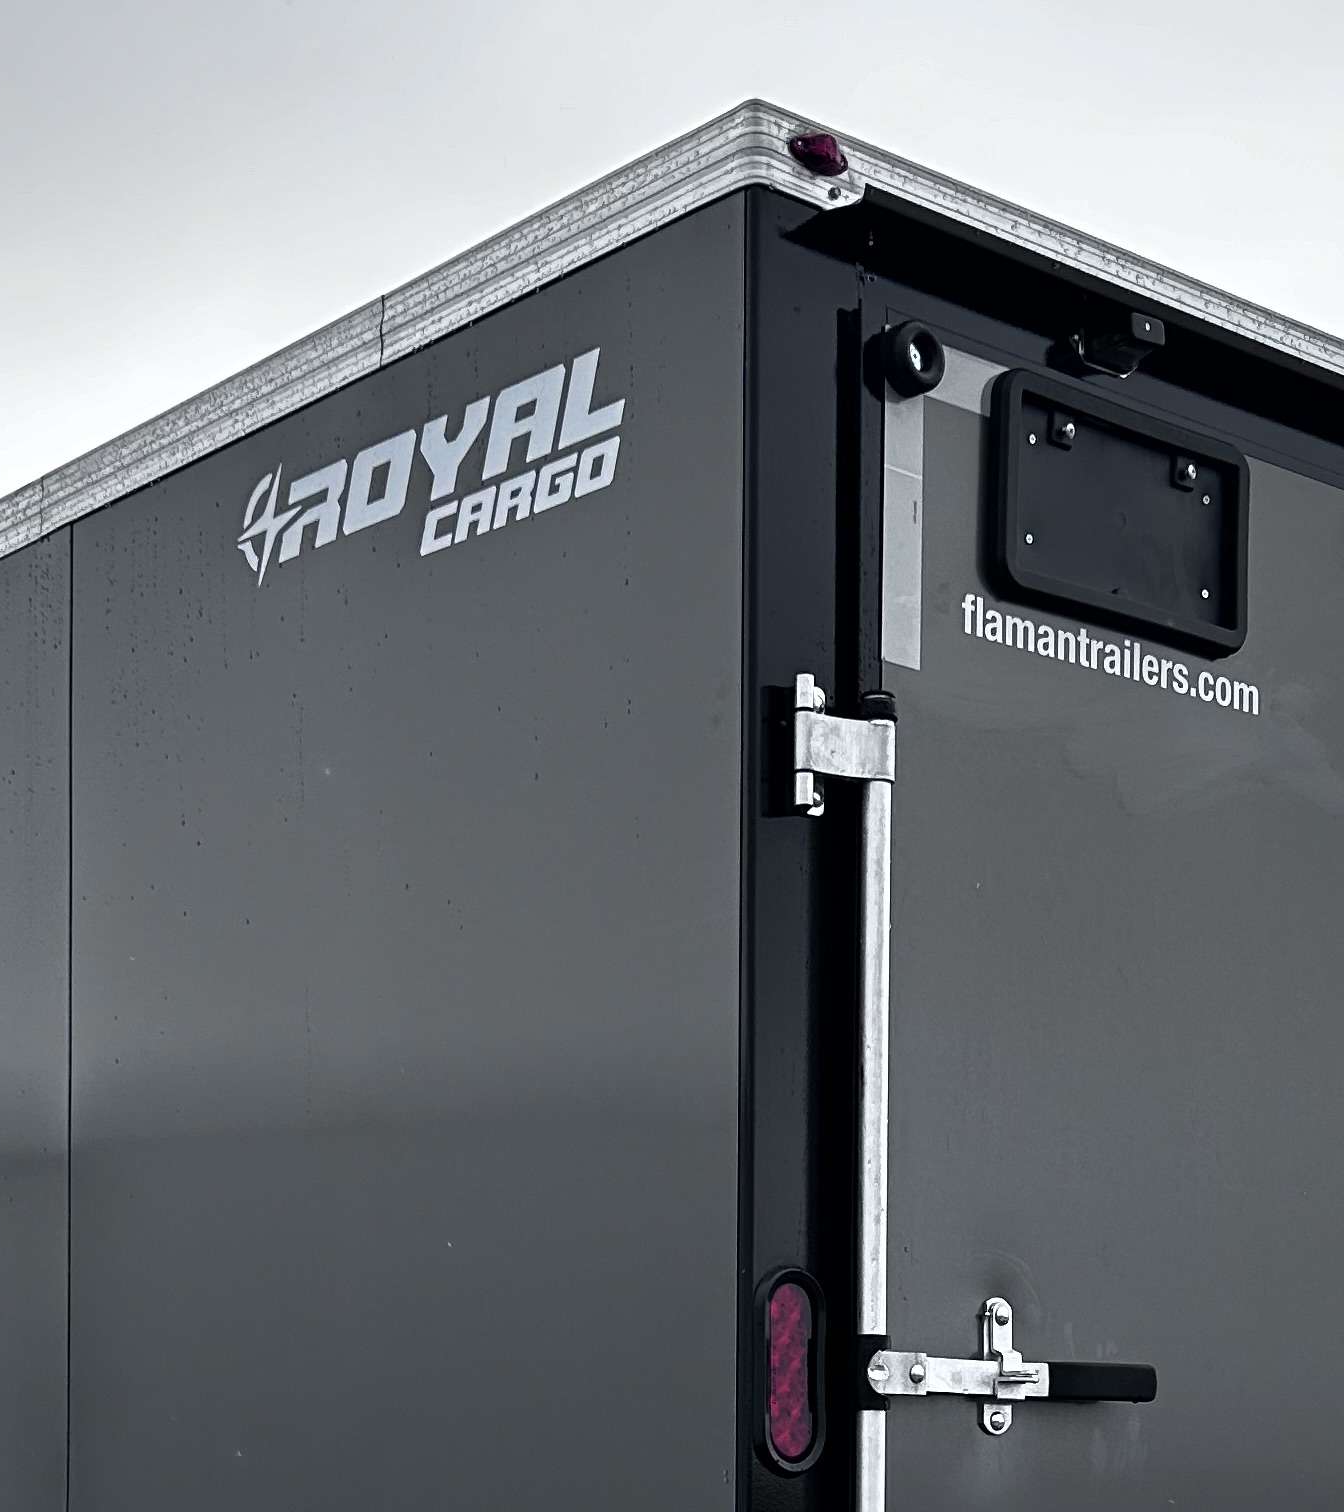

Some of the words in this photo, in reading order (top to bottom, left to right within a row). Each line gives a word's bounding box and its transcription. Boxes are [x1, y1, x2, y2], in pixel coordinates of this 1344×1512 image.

[278, 347, 626, 564] ROYAL
[420, 436, 621, 556] CARGO
[962, 594, 1260, 715] flamantrailers.com
